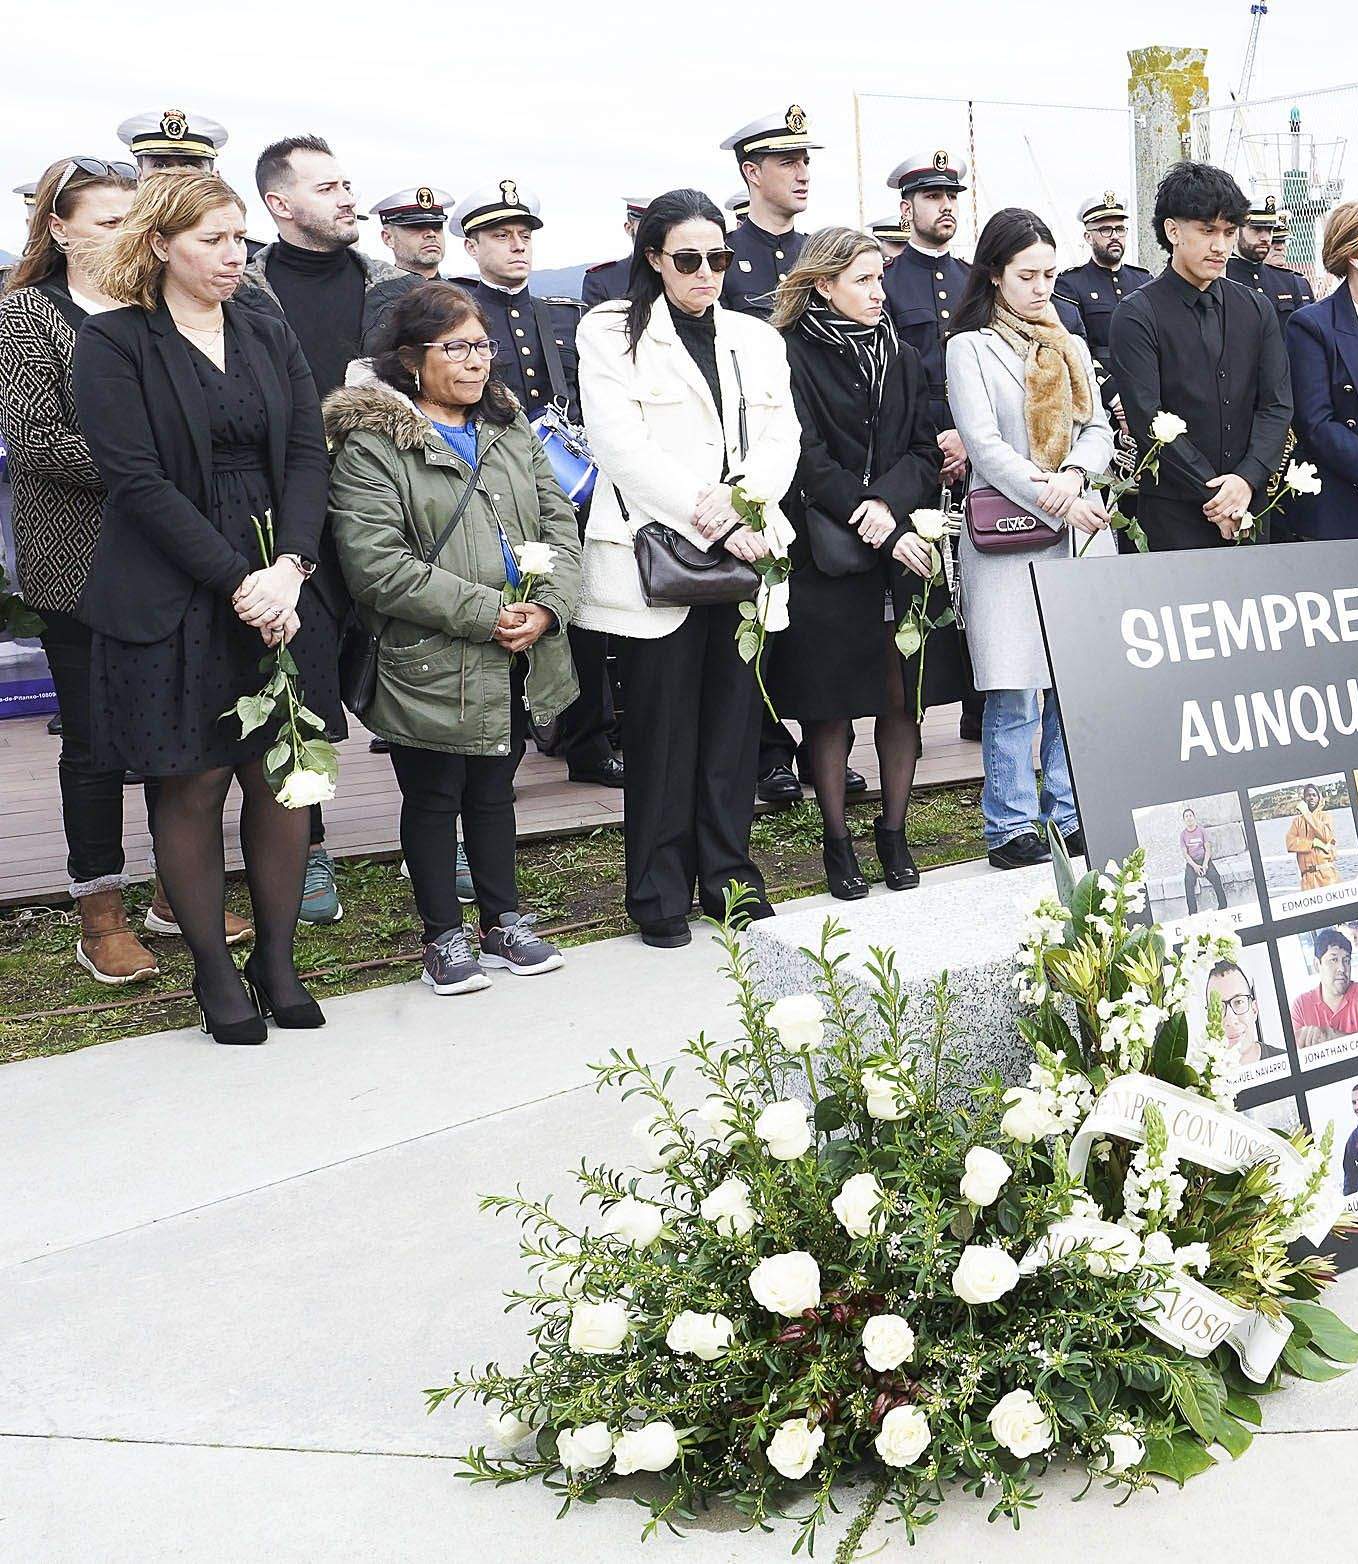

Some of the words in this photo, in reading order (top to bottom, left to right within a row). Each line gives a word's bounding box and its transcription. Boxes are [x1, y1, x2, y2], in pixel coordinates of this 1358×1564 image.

[1282, 895, 1324, 912] EDMOND
[1325, 887, 1358, 902] OKUTU
[1304, 1043, 1349, 1065] JONATHAN
[1255, 1060, 1287, 1077] NAVARRO
[1173, 1108, 1219, 1148] CON
